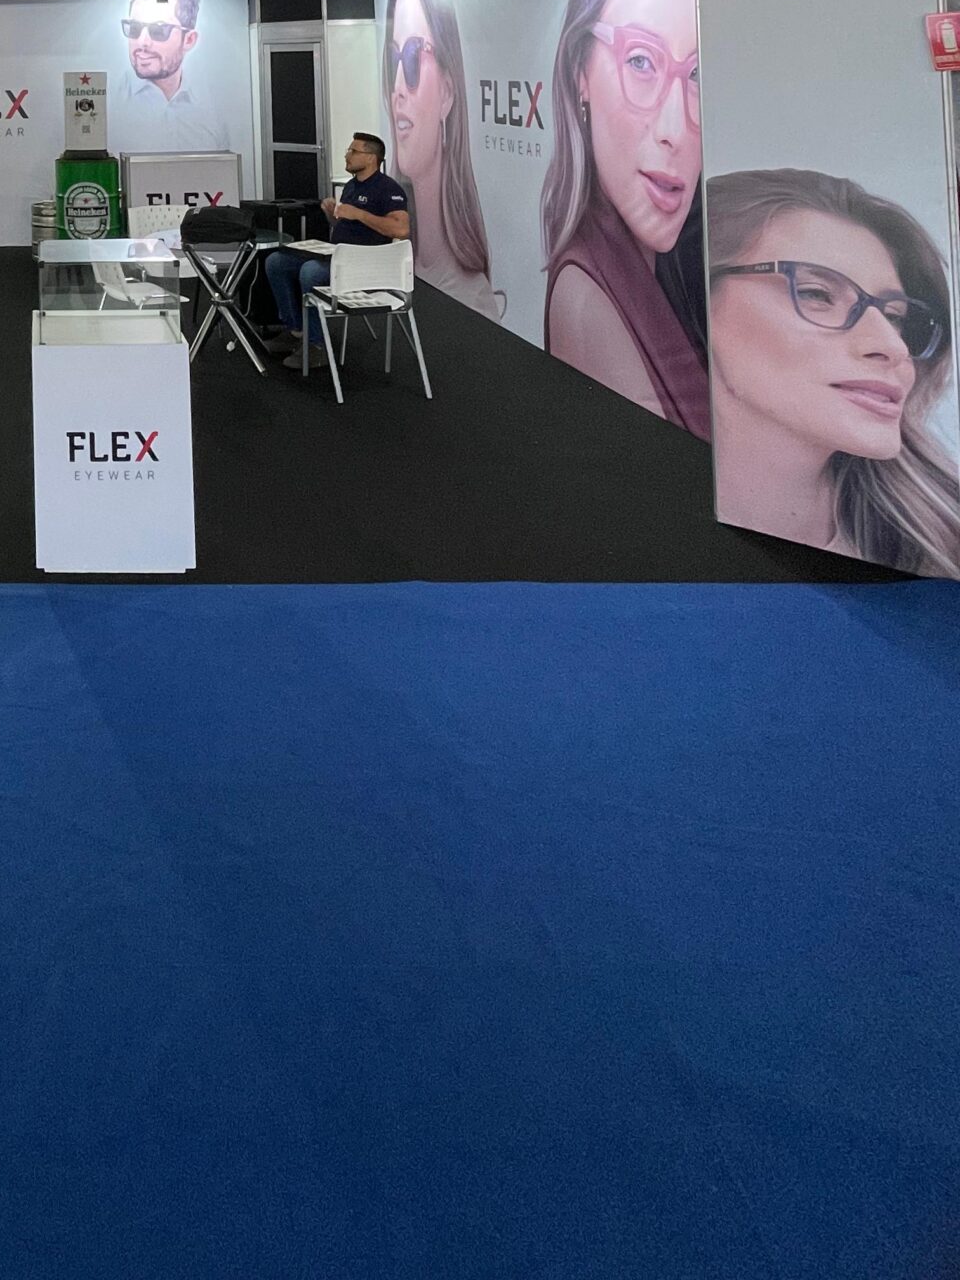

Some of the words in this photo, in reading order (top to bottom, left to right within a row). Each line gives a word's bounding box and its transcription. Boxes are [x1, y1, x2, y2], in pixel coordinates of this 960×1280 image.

[65, 88, 107, 96] Heineken
[480, 80, 544, 130] FLEX
[485, 134, 542, 157] EYEWEAR
[67, 207, 107, 216] Heineken
[66, 431, 159, 462] FLEX
[74, 471, 156, 481] EYEWEAR
